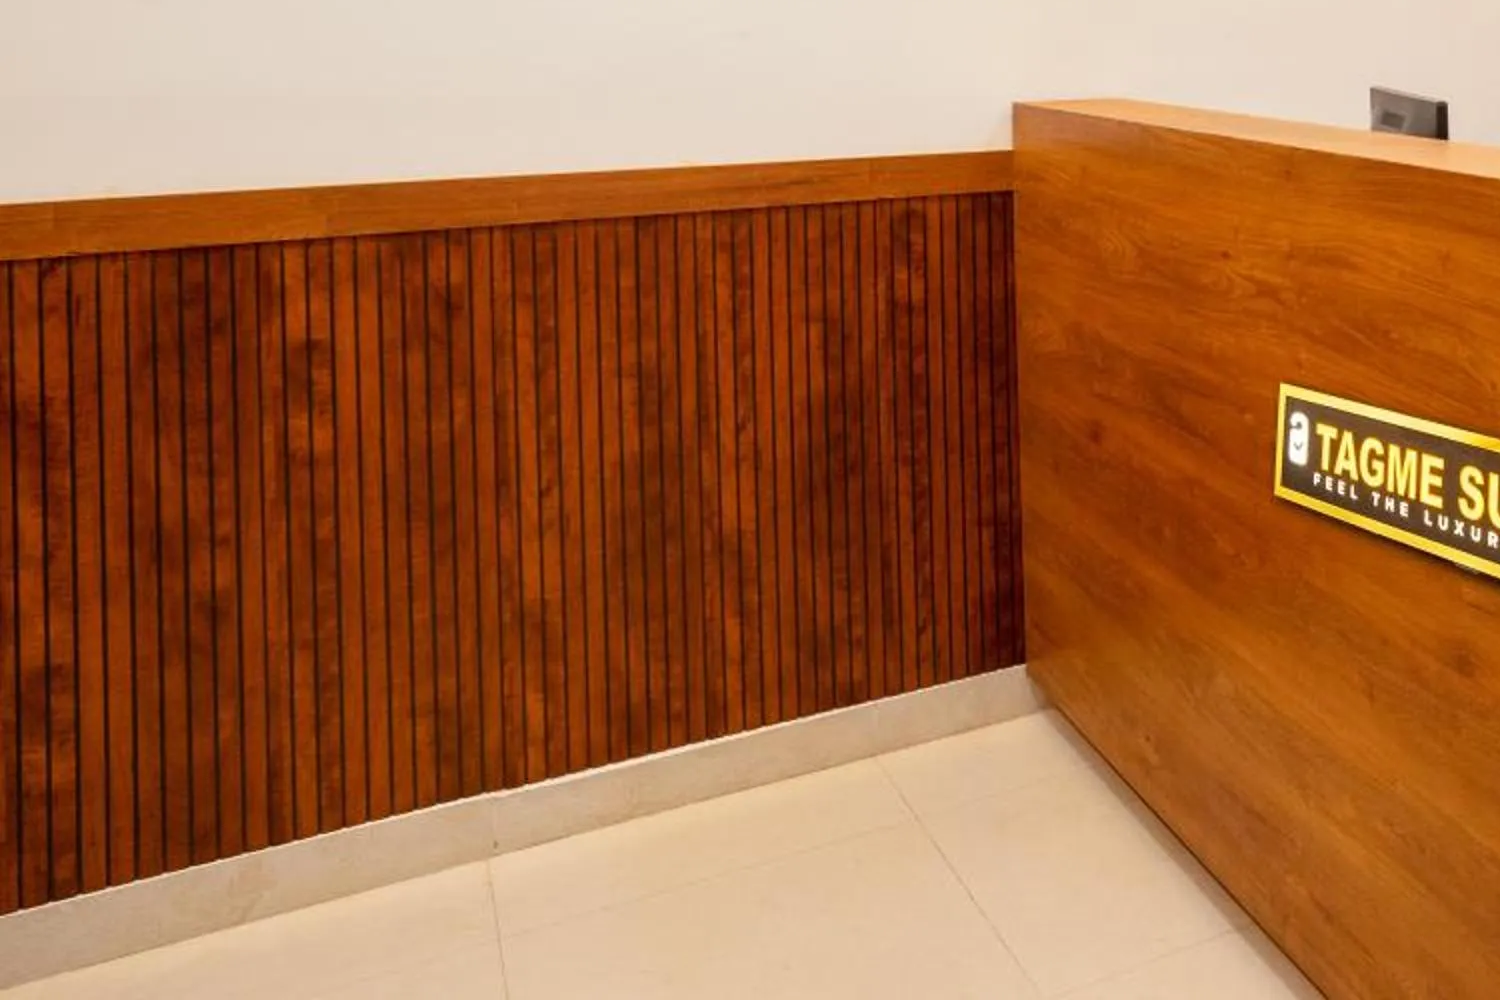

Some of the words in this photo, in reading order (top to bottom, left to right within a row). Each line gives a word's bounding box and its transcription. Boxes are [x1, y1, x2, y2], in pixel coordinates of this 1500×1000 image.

[1313, 472, 1360, 501] FEEL
[1371, 492, 1410, 519] THE
[1315, 422, 1445, 509] TAGME
